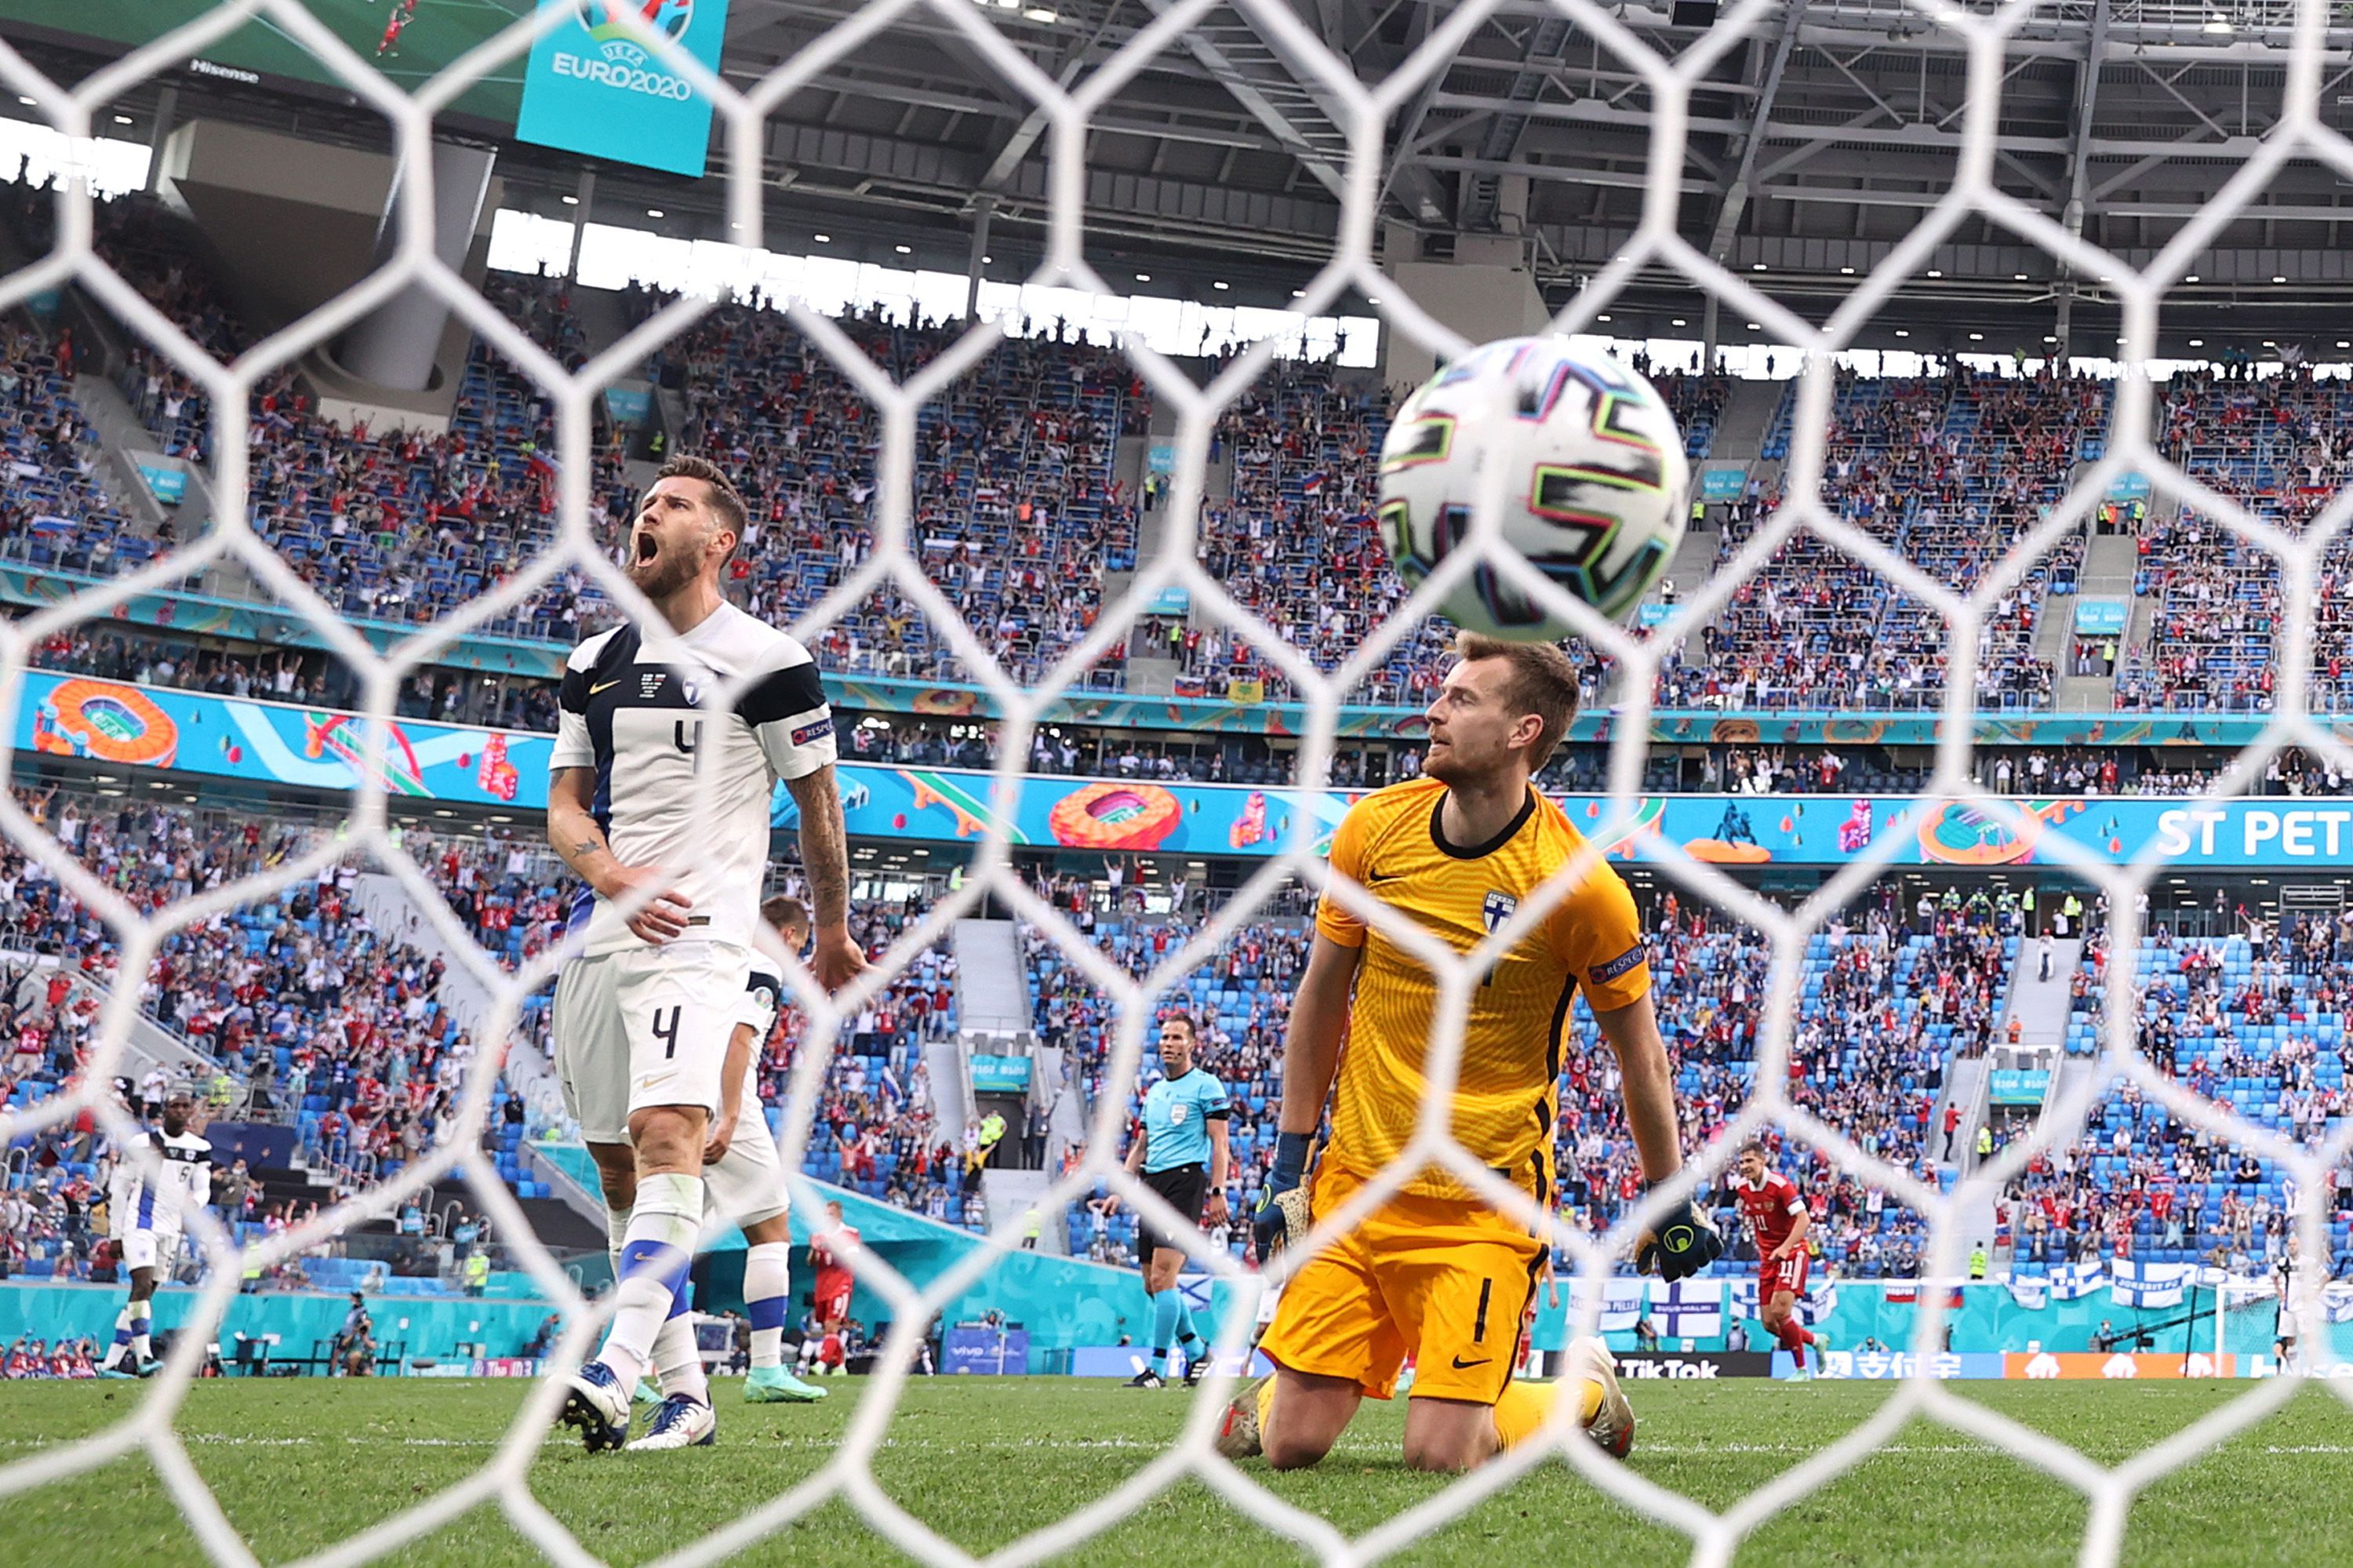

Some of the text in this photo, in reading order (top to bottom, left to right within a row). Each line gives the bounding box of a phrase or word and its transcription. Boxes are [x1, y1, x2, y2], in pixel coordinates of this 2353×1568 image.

[601, 43, 646, 67] UEFA
[190, 58, 260, 84] Hisense
[552, 52, 692, 101] EURO2020
[675, 719, 703, 775] 4
[2156, 809, 2351, 856] ST PET
[1606, 949, 1642, 976] RESPECT
[652, 1006, 682, 1059] 4
[178, 1166, 191, 1183] 6
[1755, 1214, 1769, 1231] 11
[1778, 1260, 1794, 1277] 11
[1473, 1277, 1492, 1343] 1
[951, 1344, 984, 1356] vivo
[488, 1361, 508, 1377] The
[1620, 1359, 1719, 1379] TikTok
